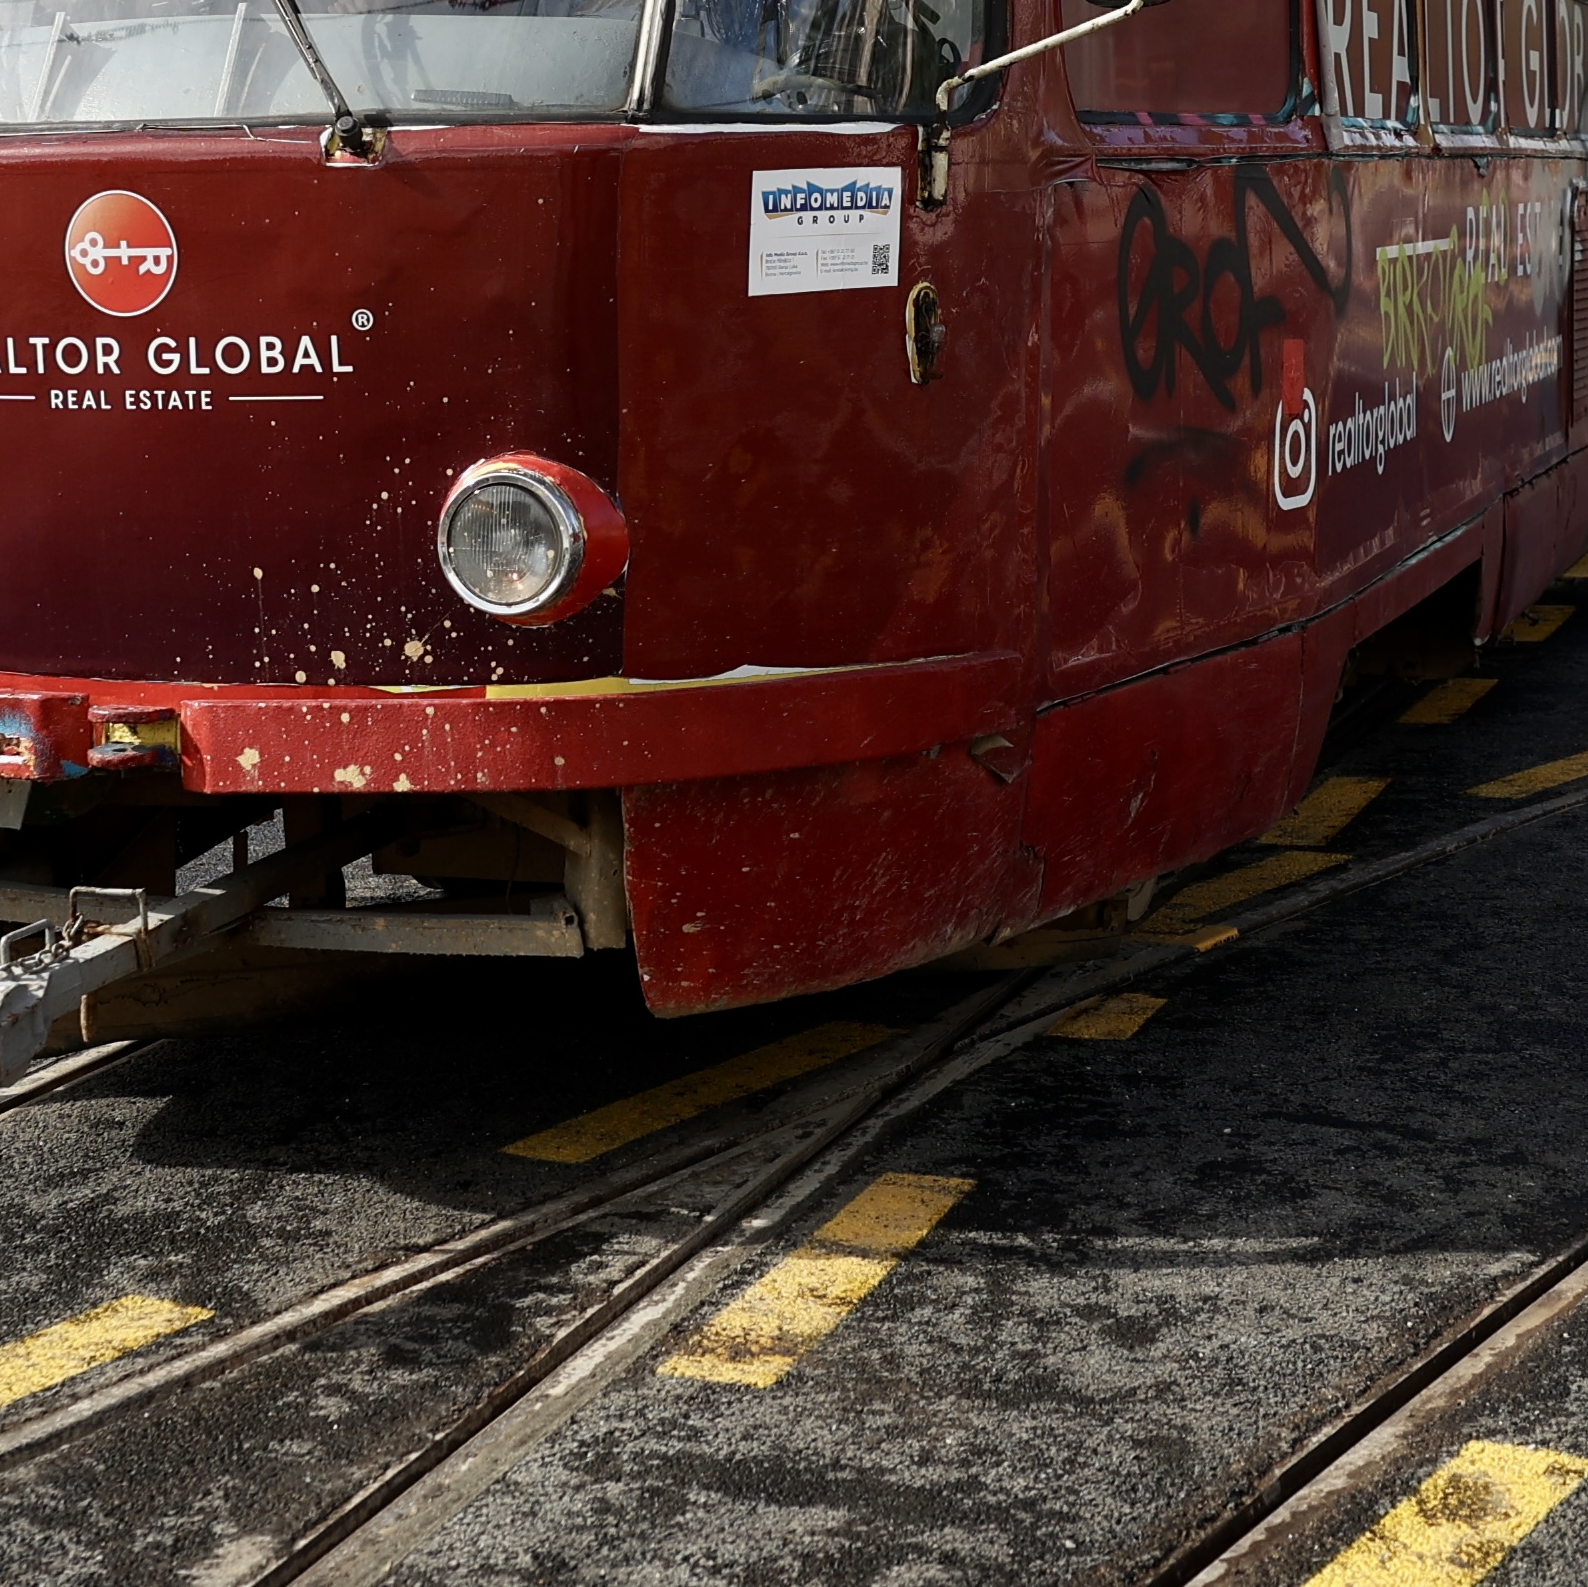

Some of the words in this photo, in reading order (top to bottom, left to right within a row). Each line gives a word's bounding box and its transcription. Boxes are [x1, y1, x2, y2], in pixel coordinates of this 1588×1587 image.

[767, 191, 891, 210] INFOMEDIA
[797, 214, 865, 226] GROUP
[147, 336, 353, 375] GLOBAL
[51, 390, 111, 409] REAL
[126, 390, 212, 409] ESTATE
[1328, 371, 1417, 476] realtorglobal
